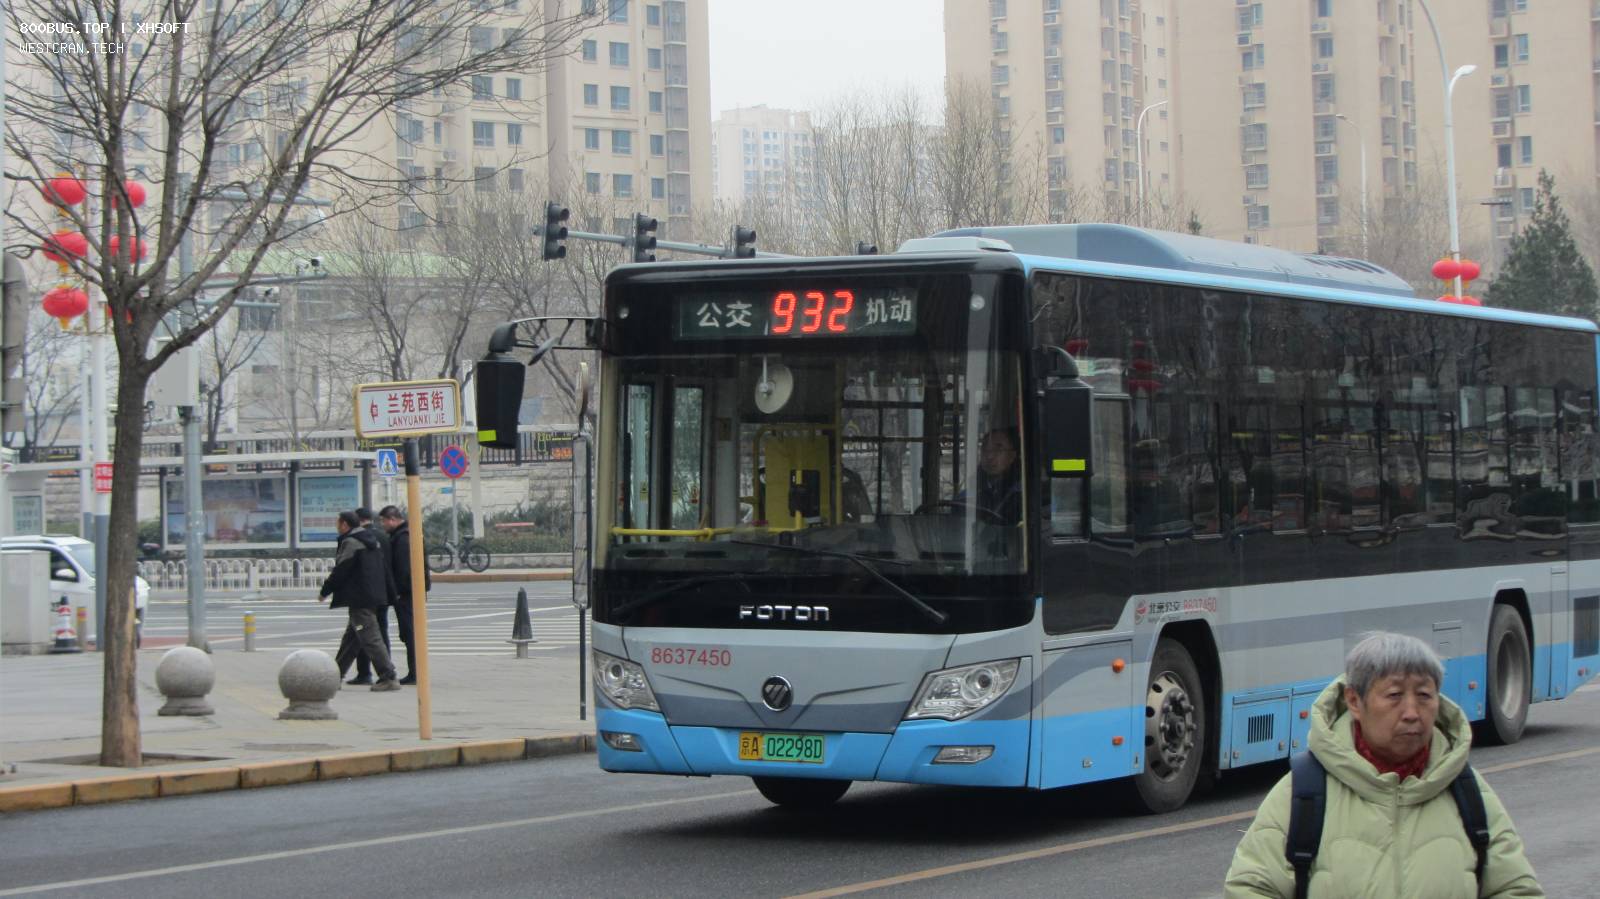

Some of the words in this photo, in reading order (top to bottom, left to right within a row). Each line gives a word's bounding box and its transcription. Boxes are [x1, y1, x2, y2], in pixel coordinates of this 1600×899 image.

[697, 301, 752, 328] 公交
[772, 291, 854, 333] 932
[866, 298, 912, 323] 机动
[387, 390, 444, 414] 兰苑西街
[435, 413, 446, 424] JIE
[739, 605, 830, 621] FOTON
[651, 648, 732, 667] 8637450
